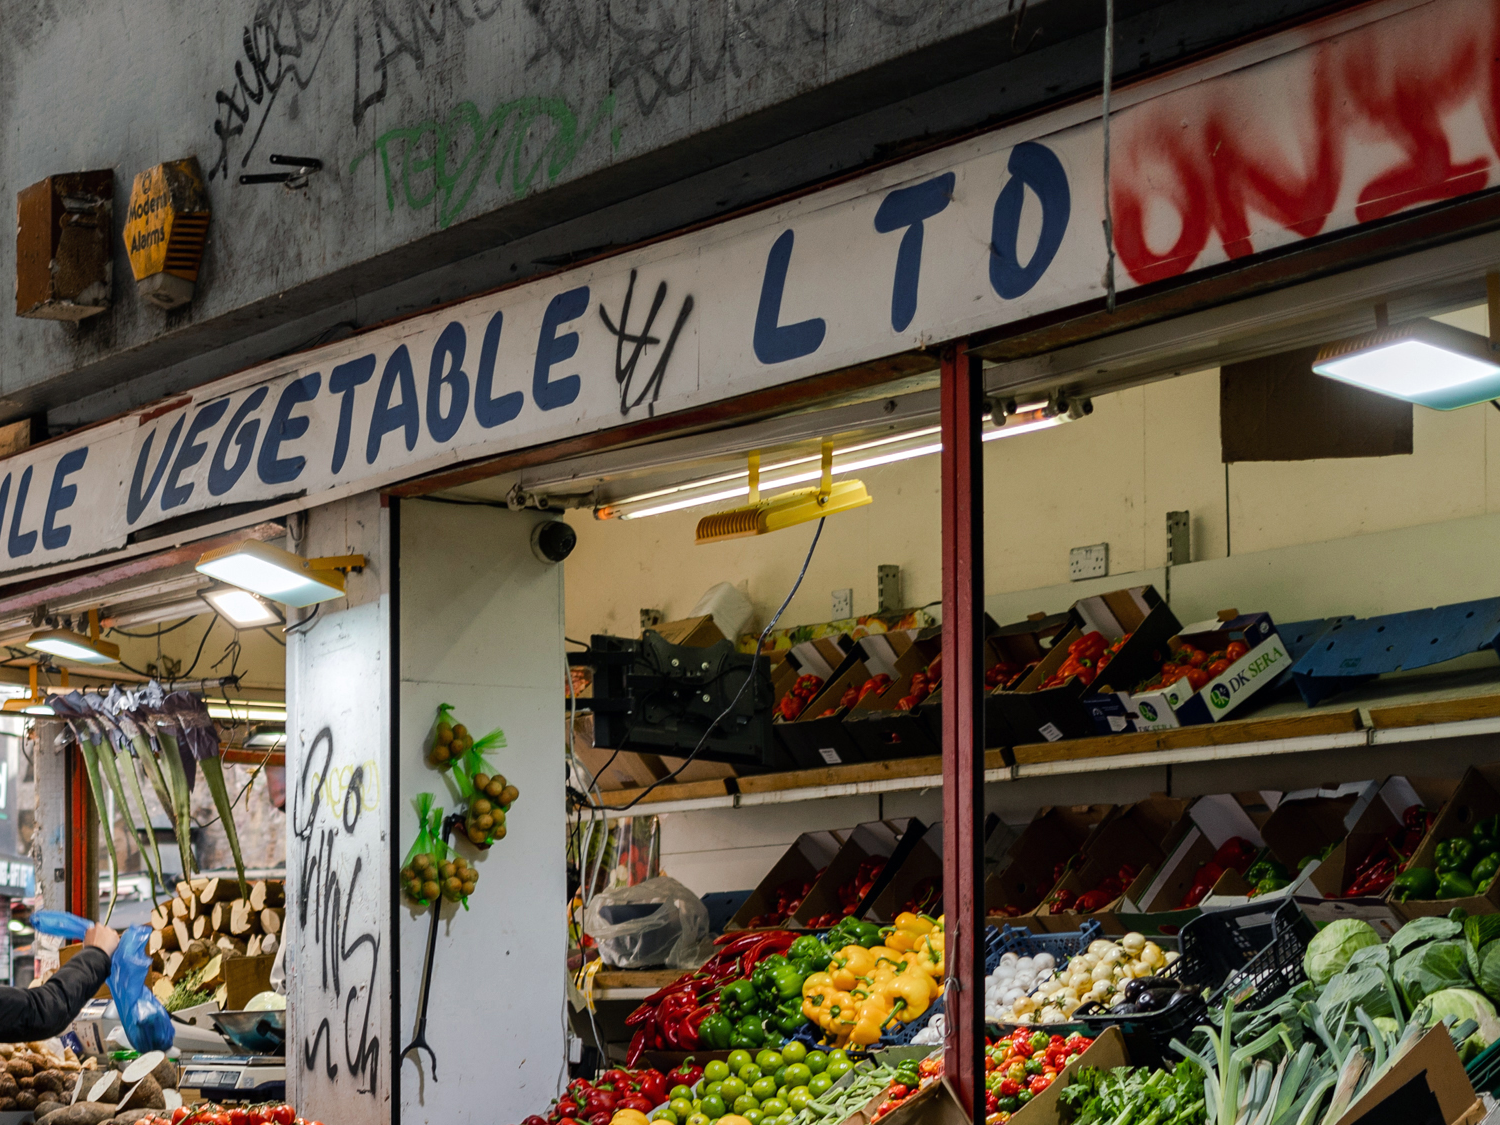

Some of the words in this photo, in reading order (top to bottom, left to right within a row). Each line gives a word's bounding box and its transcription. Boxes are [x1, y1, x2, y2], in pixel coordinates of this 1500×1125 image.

[130, 226, 165, 255] Alarms
[126, 285, 591, 526] VEGETABLE
[1228, 671, 1250, 694] DK
[1247, 645, 1284, 678] SERA
